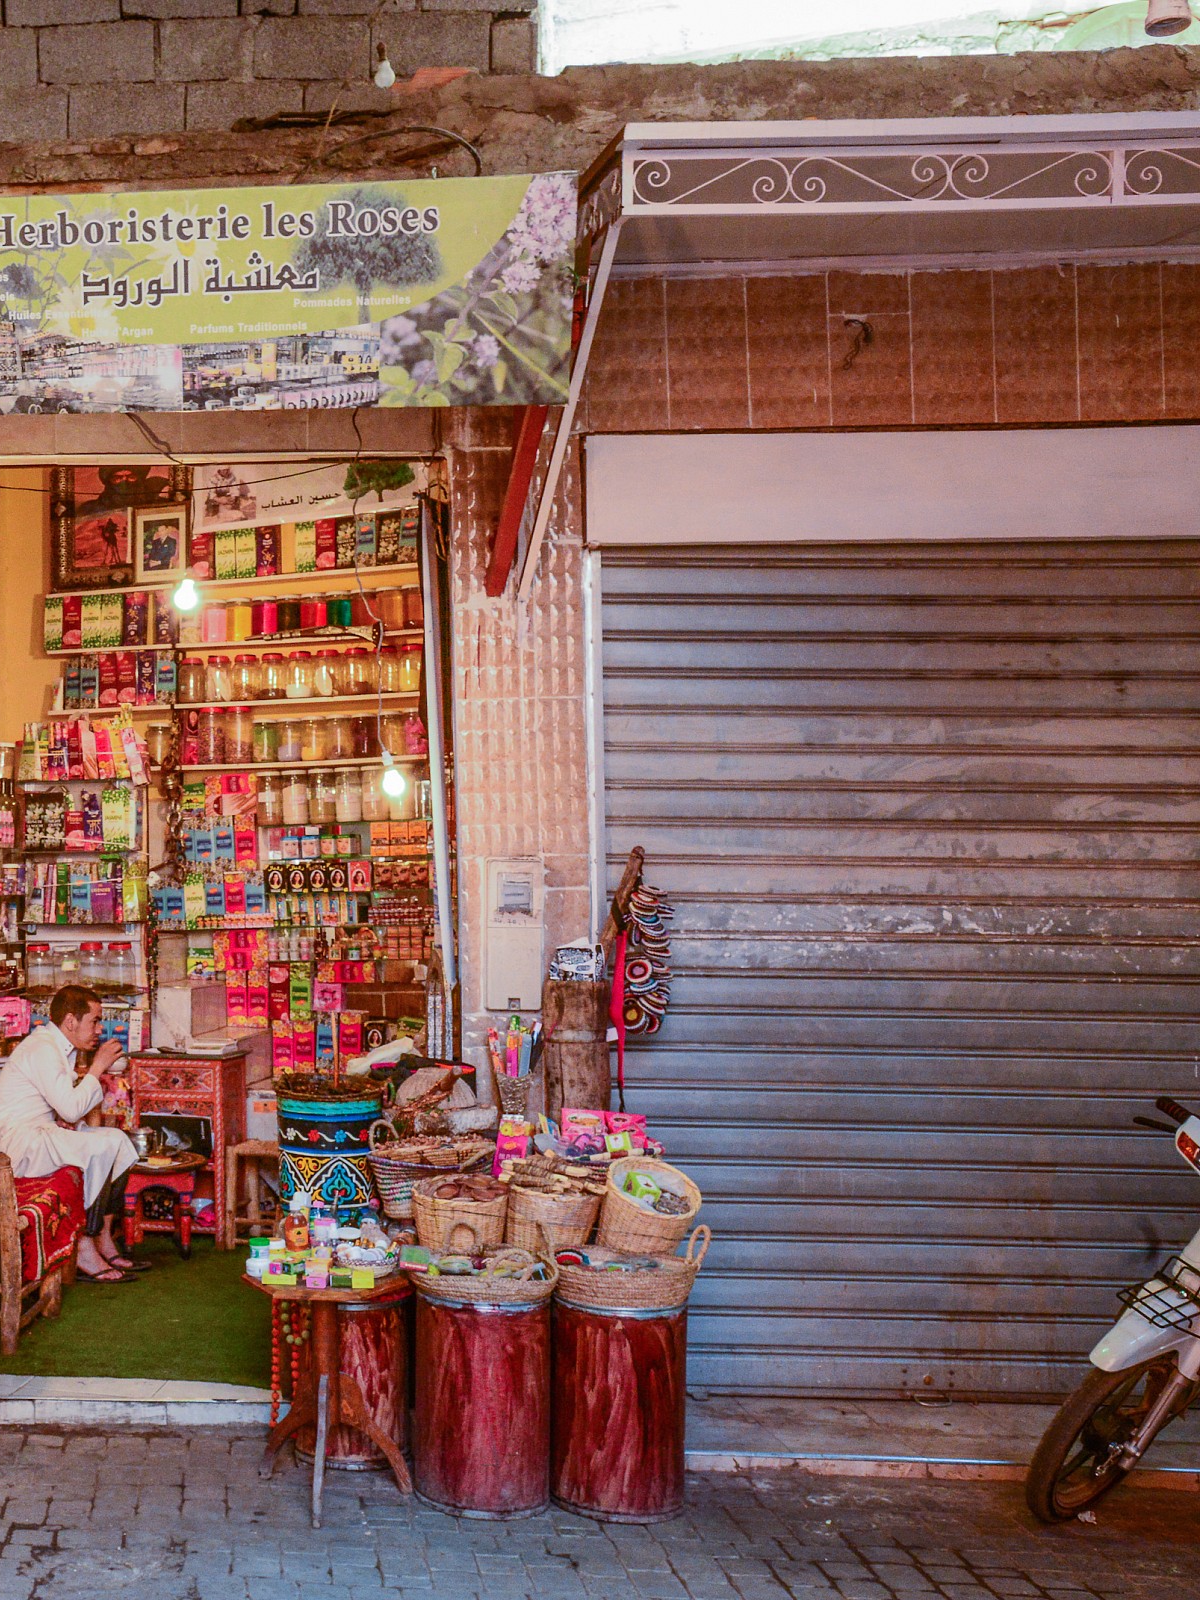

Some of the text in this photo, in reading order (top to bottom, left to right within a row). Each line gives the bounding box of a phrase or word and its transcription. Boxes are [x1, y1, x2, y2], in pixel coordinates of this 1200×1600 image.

[262, 202, 315, 238] les
[327, 201, 440, 236] Roses
[82, 251, 320, 308] معشبة الورود
[293, 294, 411, 308] Pommades Naturelles
[8, 309, 109, 321] Huiles Esentiell
[112, 326, 154, 339] d'Argan
[190, 321, 308, 335] Parfums Traditionnels
[309, 491, 343, 506] حسين
